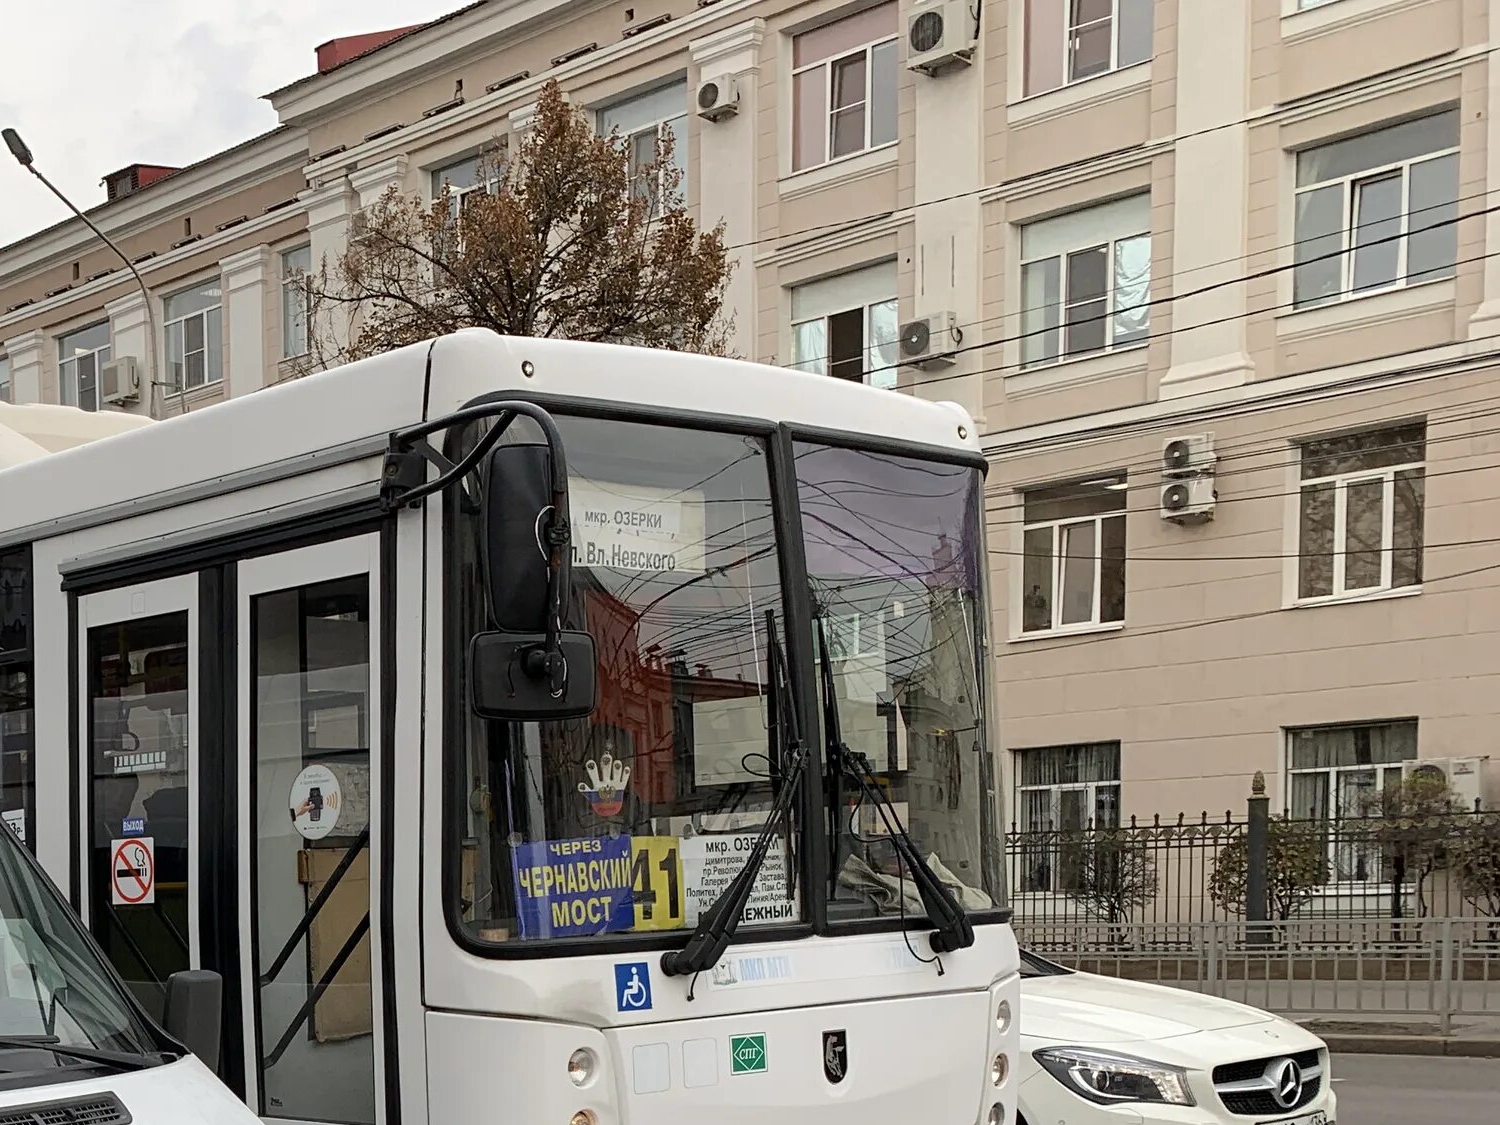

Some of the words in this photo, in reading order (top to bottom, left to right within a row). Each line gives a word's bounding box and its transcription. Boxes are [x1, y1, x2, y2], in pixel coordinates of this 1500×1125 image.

[585, 511, 610, 526] мкр.
[614, 510, 662, 528] ОЗЕРКИ
[123, 820, 144, 831] ВЫХОД
[551, 840, 602, 856] ЧЕРЕЗ
[705, 841, 731, 856] мкр.
[519, 850, 631, 898] ЧЕРНАВСКИЙ
[701, 876, 729, 888] Галерея
[632, 848, 679, 920] 41
[551, 896, 612, 928] МОСТ
[739, 1046, 758, 1060] СПГ
